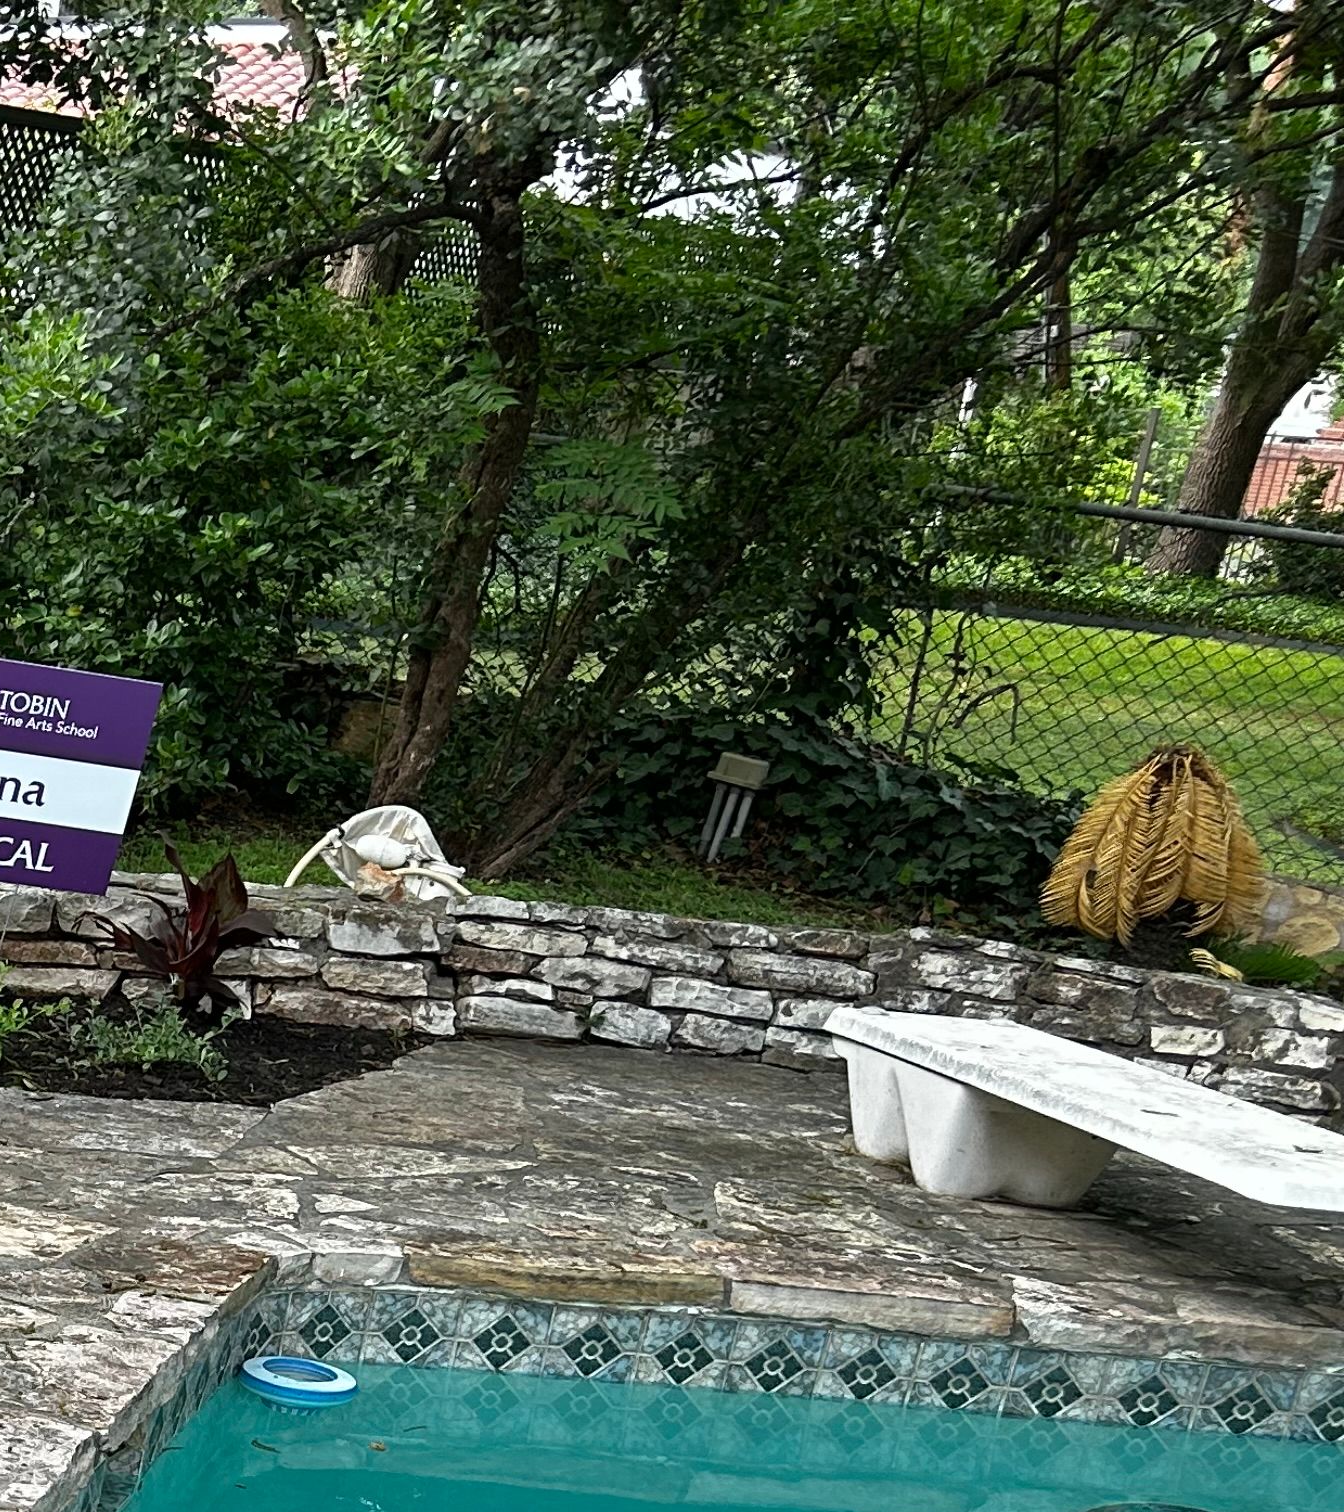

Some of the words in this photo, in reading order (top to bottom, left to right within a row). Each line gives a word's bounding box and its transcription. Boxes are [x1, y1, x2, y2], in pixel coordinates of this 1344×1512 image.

[0, 689, 71, 720] TOBIN
[24, 715, 53, 733] Arts
[55, 720, 100, 740] School
